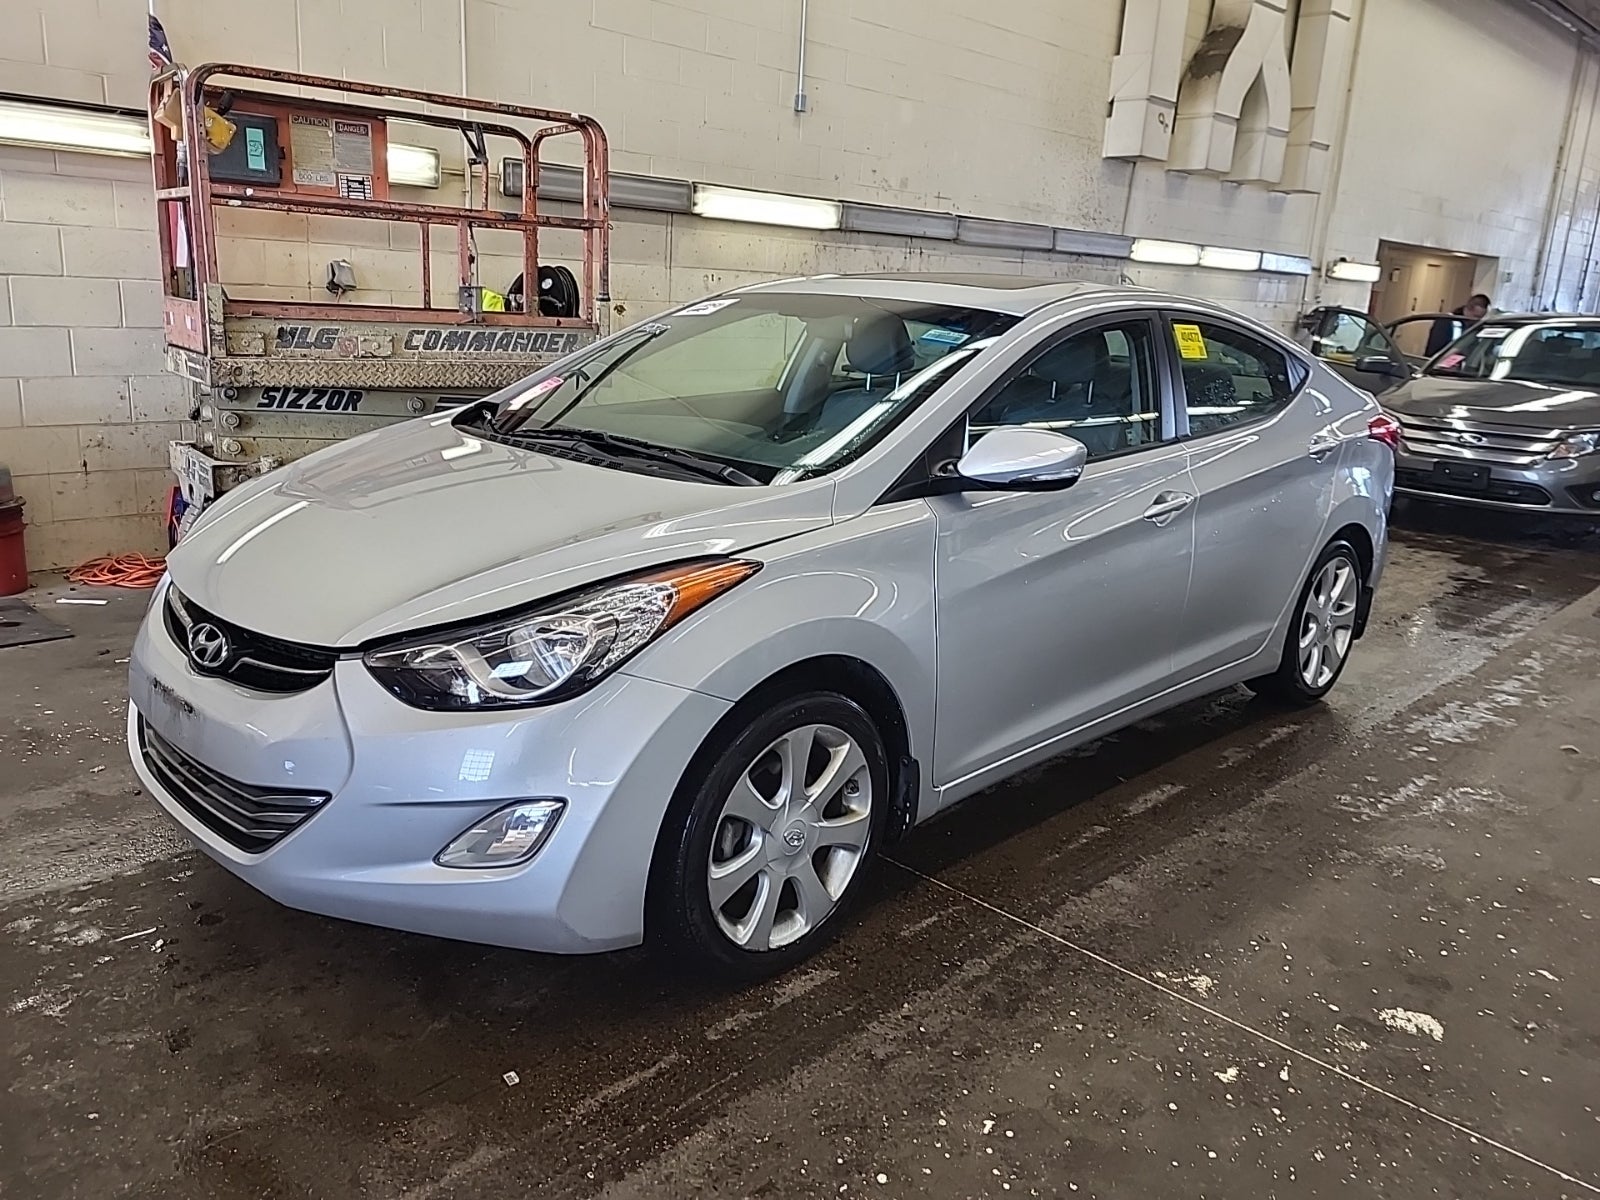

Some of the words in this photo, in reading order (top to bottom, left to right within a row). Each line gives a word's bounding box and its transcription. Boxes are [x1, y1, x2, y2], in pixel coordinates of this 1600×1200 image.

[292, 116, 329, 127] CAUTION
[338, 123, 366, 134] DANGER
[404, 329, 579, 353] COMMANDER
[257, 387, 363, 411] SIZZOR
